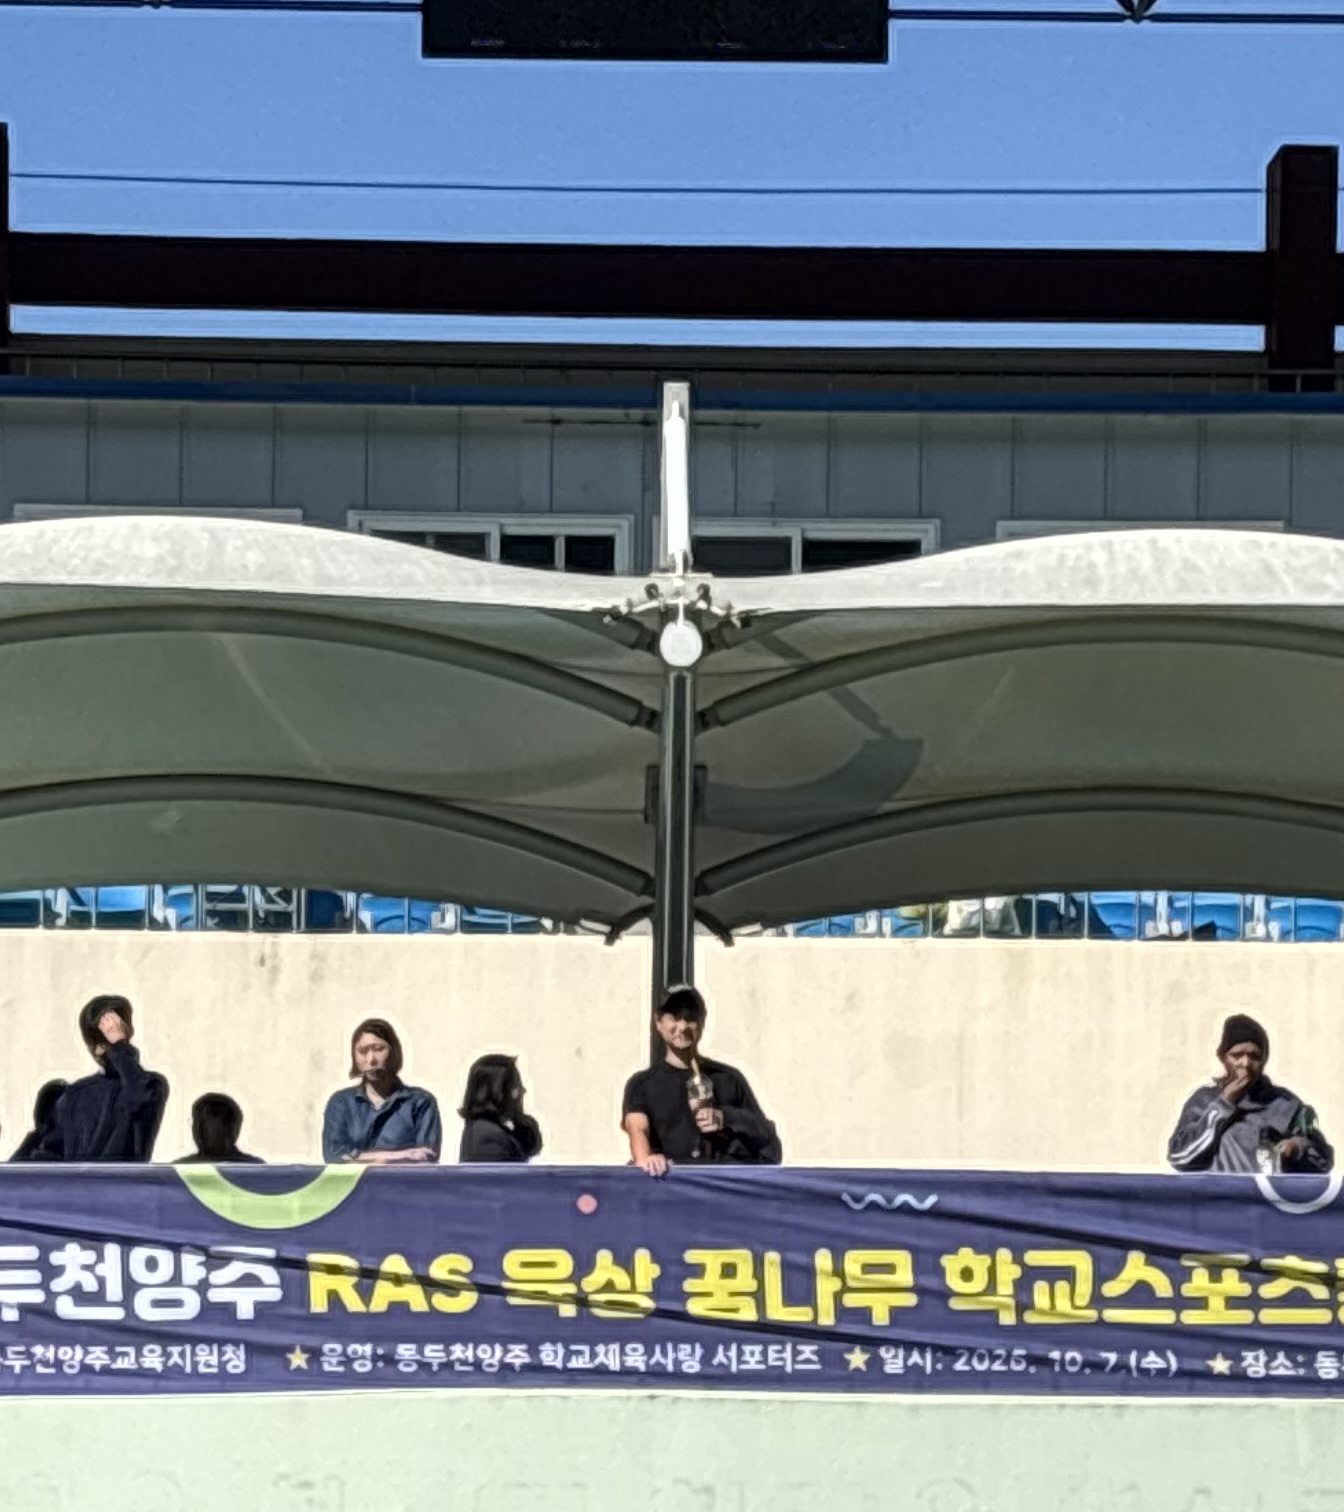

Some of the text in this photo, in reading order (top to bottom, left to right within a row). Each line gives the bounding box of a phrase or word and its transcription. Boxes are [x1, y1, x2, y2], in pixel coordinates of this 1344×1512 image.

[306, 1252, 479, 1314] RAS
[682, 1246, 919, 1327] 꿈나무
[319, 1343, 386, 1373] 운영:
[394, 1343, 532, 1373] 동두천양주
[538, 1341, 705, 1374] 학교체육사랑
[711, 1343, 822, 1374] 서포터즈
[879, 1345, 944, 1376] 일시:
[1047, 1350, 1092, 1376] 10.
[1240, 1348, 1307, 1379] 장소:
